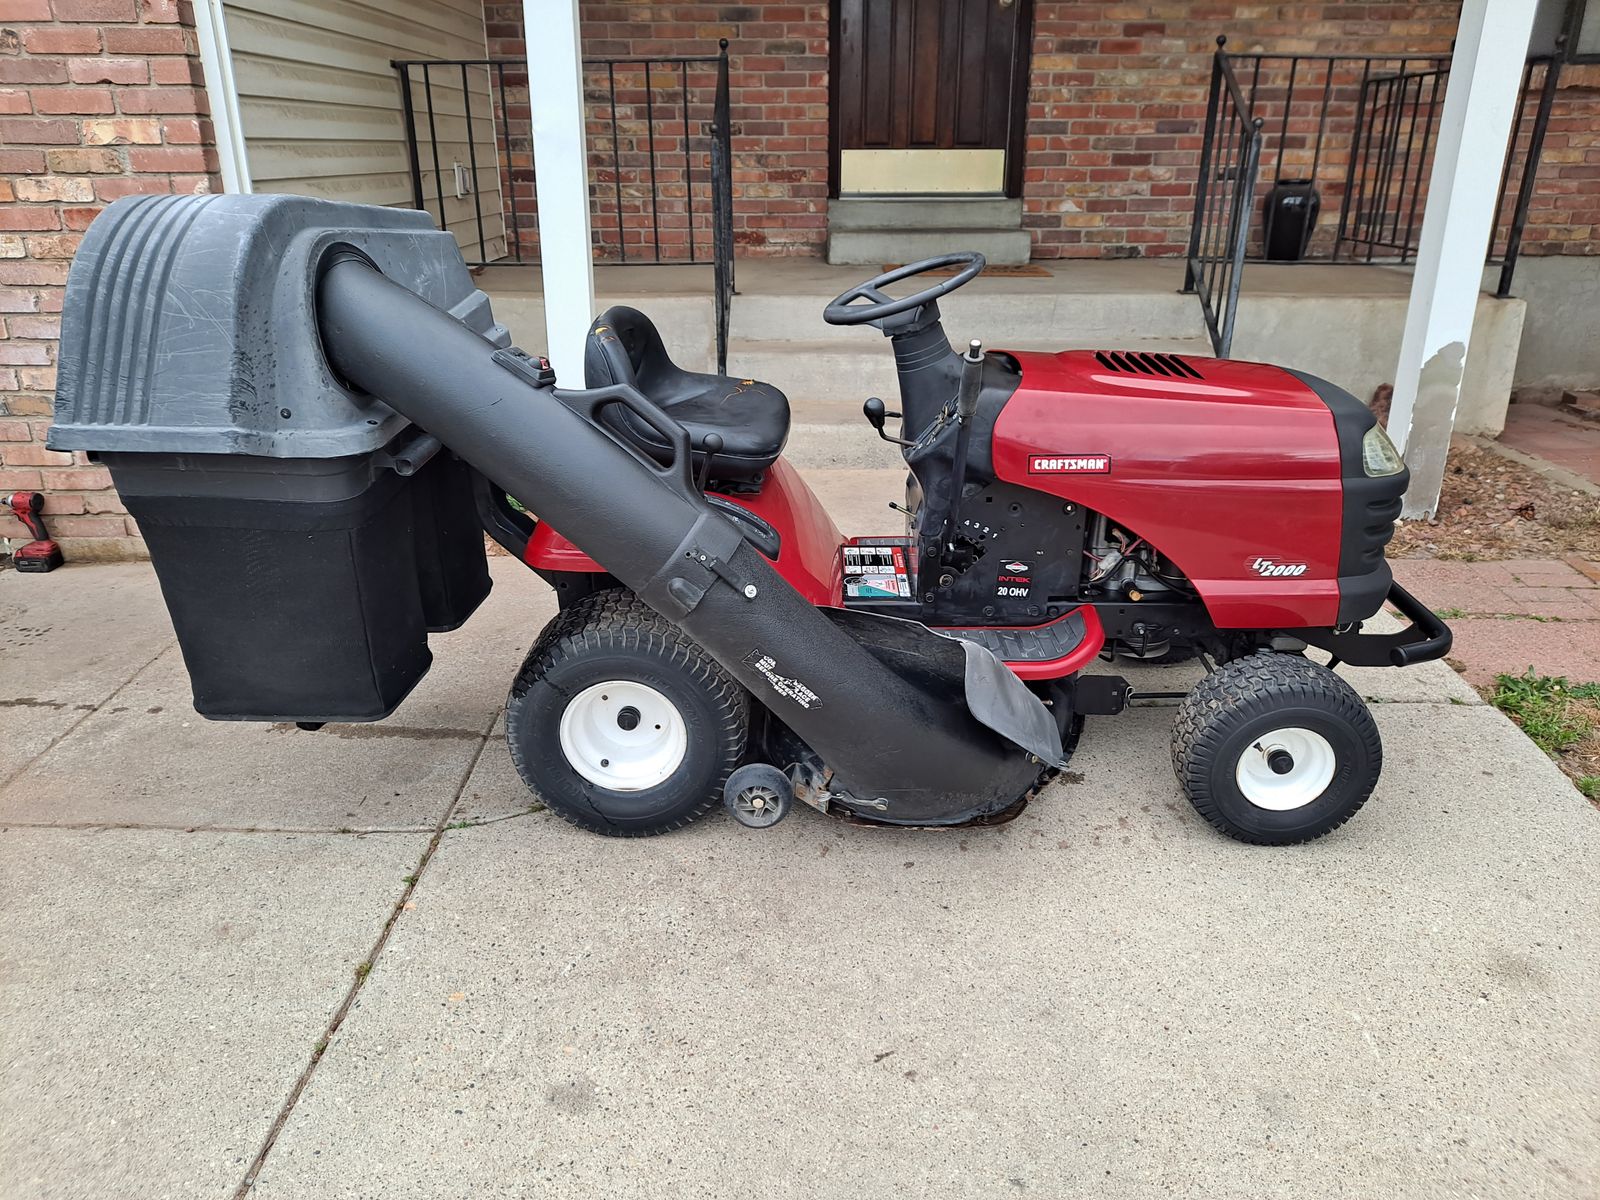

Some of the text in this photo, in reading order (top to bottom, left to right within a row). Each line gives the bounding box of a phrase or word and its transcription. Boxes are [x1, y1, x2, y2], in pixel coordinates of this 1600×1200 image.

[982, 526, 990, 534] 2
[998, 575, 1031, 583] INTEK
[997, 586, 1029, 597] 20 OHV
[755, 662, 778, 682] BEFORE
[778, 681, 810, 709] OPERATING
[794, 687, 810, 702] LACE
